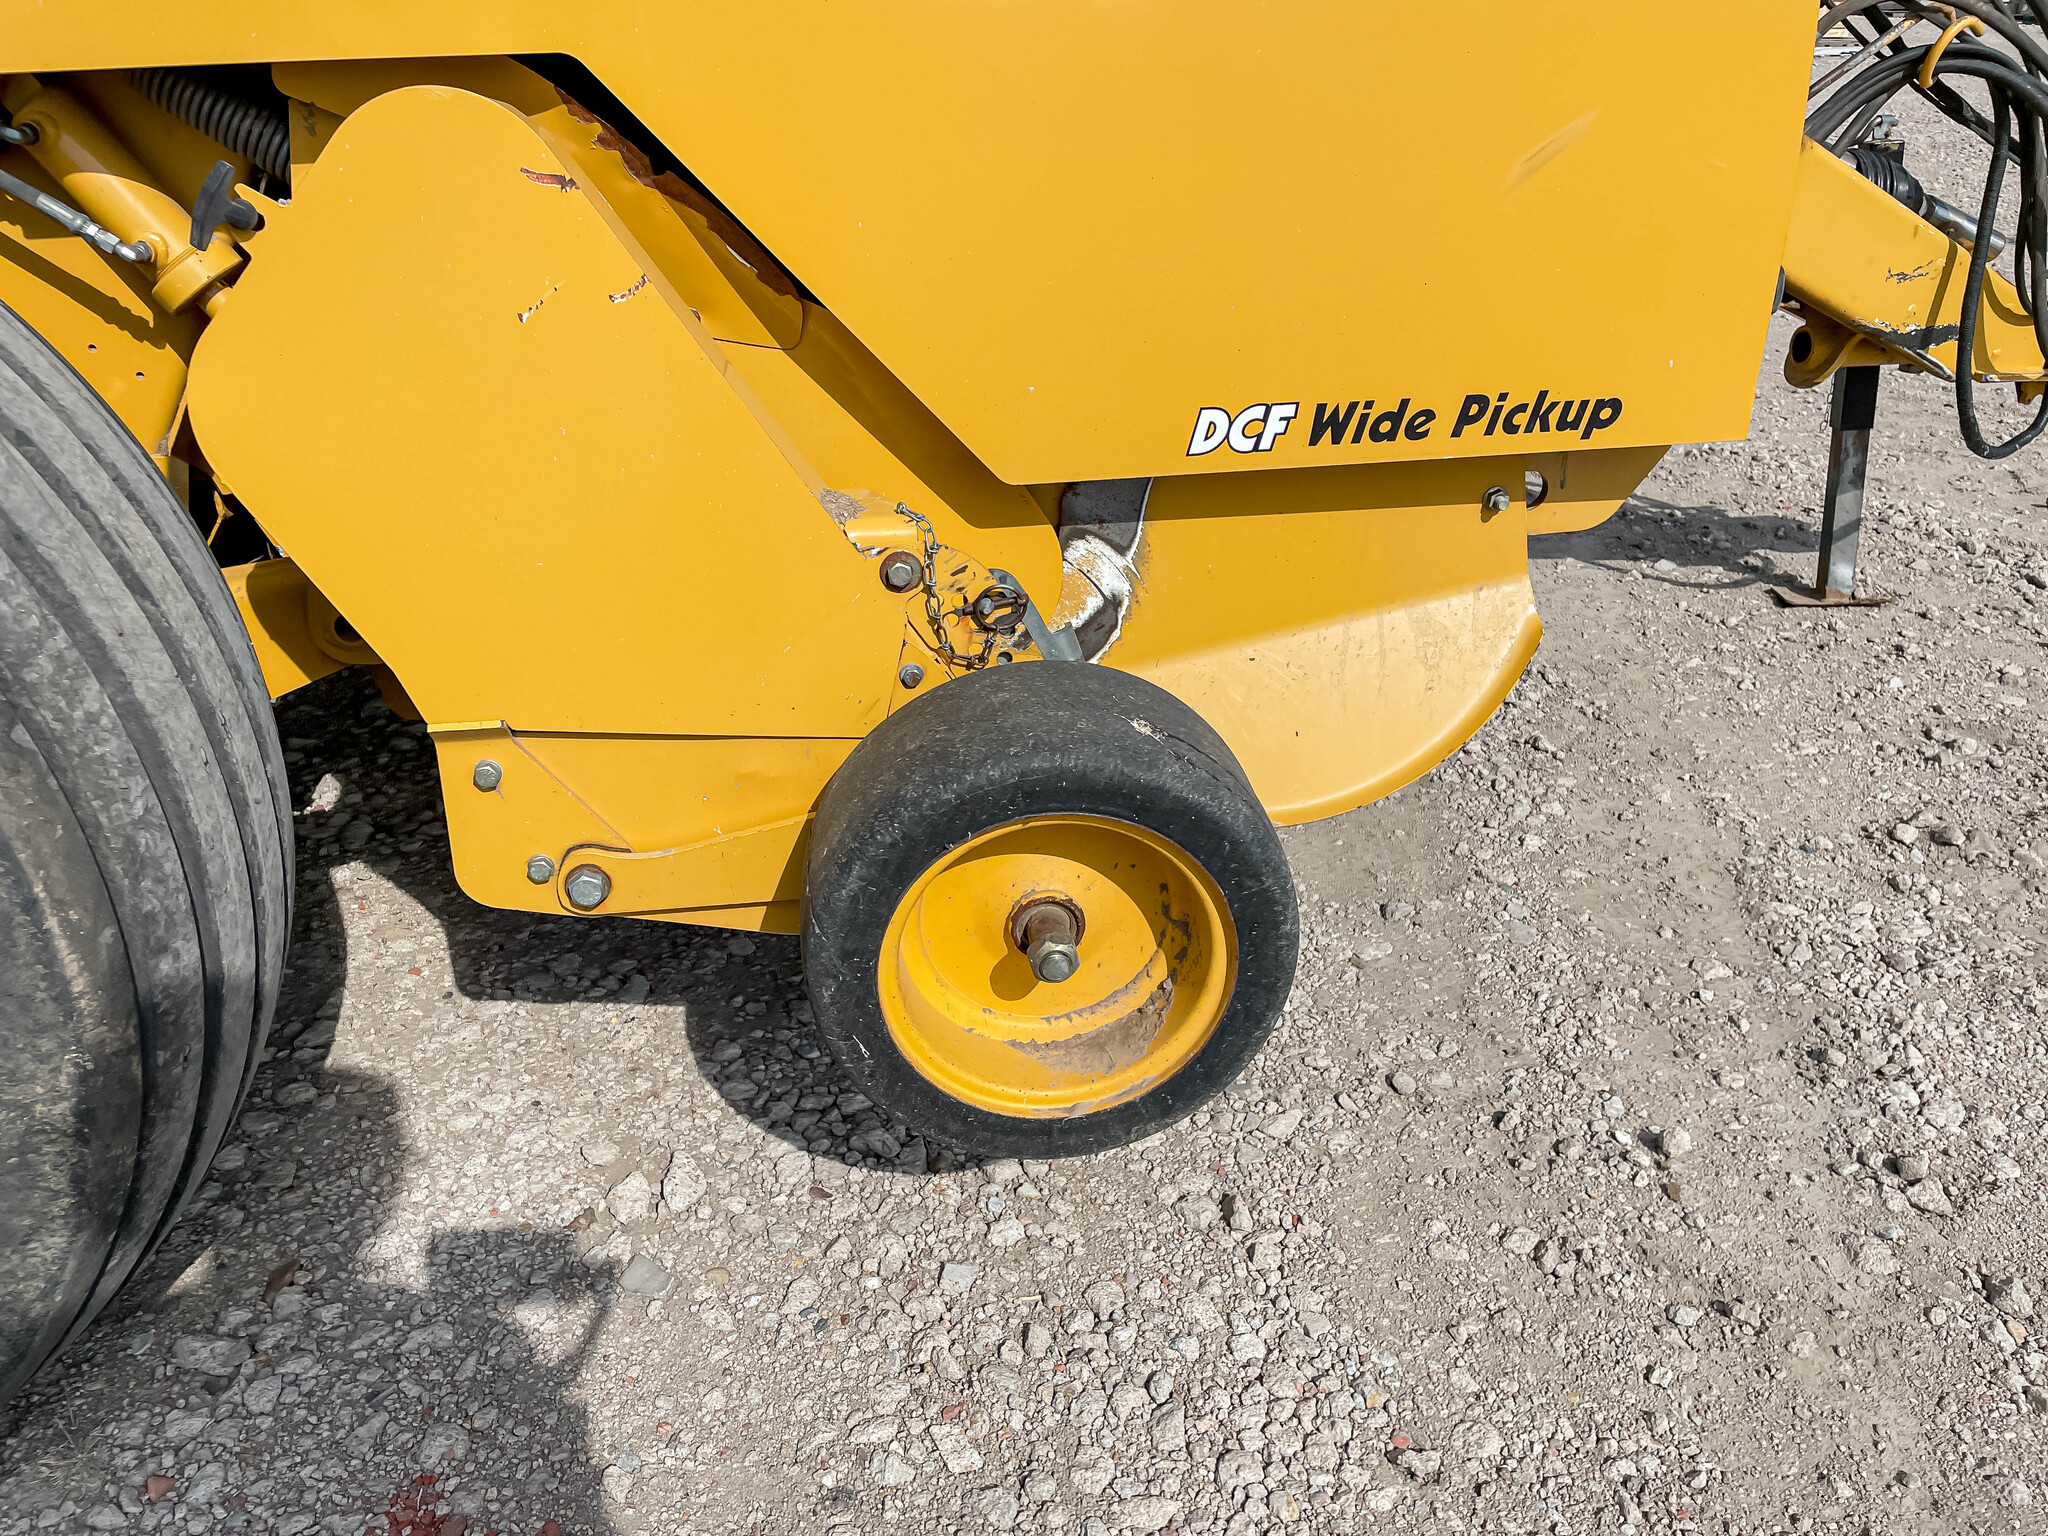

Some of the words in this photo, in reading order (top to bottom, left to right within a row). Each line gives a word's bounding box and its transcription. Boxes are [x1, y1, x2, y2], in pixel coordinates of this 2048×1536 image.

[1186, 401, 1300, 457] DCF
[1308, 397, 1437, 447] Wide
[1450, 389, 1623, 441] Pickup
